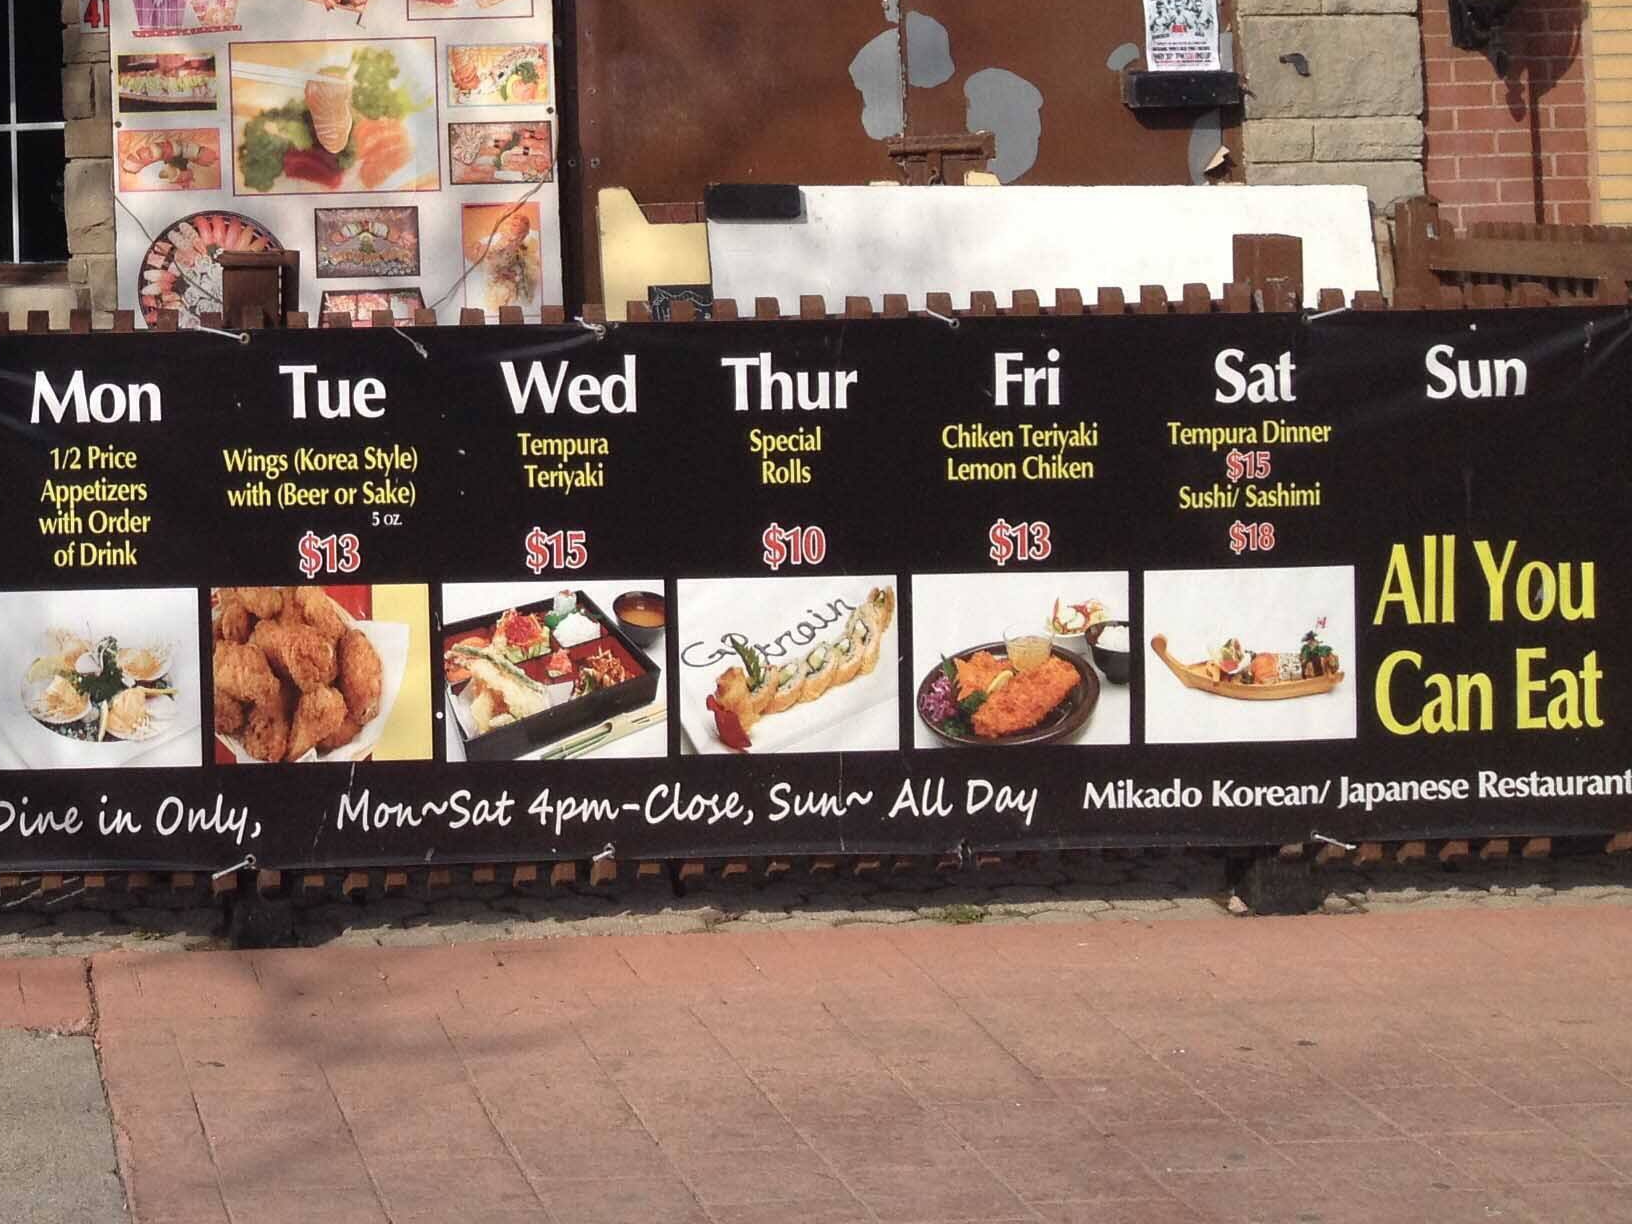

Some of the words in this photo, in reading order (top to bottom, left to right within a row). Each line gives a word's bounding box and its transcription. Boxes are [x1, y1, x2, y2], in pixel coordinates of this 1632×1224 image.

[499, 354, 637, 415] Wed
[720, 351, 858, 411] Thur
[994, 348, 1060, 406] Fri
[1214, 348, 1297, 404] Sat
[1425, 344, 1528, 400] Sun
[30, 369, 162, 424] Mon
[278, 364, 387, 419] Tue
[517, 432, 609, 463] Tempura
[749, 425, 822, 460] Special
[942, 422, 1014, 449] Chiken
[1018, 421, 1098, 454] Teriyaki
[1167, 421, 1258, 451] Tempura
[1262, 418, 1332, 444] Dinner
[49, 446, 82, 470] 1/2
[87, 444, 137, 470] Price
[222, 447, 289, 479] Wings
[294, 447, 359, 474] (Korea
[364, 444, 418, 475] Style)
[762, 458, 812, 484] Rolls
[947, 457, 1017, 481] Lemon
[1022, 451, 1094, 480] Chiken
[1225, 447, 1272, 484] $15
[40, 477, 148, 509] Appetizers
[227, 481, 271, 507] with
[277, 482, 330, 510] (Beer
[334, 487, 358, 505] or
[362, 478, 416, 507] Sake)
[523, 462, 604, 495] Teriyaki
[1179, 483, 1240, 509] Sushi/
[1245, 481, 1321, 508] Sashimi
[38, 505, 83, 535] with
[89, 507, 151, 534] Order
[372, 511, 380, 526] 5
[383, 513, 403, 526] oz.
[1228, 519, 1276, 555] $18
[54, 541, 76, 567] of
[80, 539, 137, 566] Drink
[298, 530, 361, 579] $13
[524, 526, 588, 575] $15
[762, 522, 827, 571] $10
[988, 518, 1052, 567] $13
[1372, 534, 1456, 625] All
[1472, 540, 1596, 622] You
[1375, 649, 1493, 736] Can
[1515, 647, 1605, 730] Eat
[888, 777, 954, 818] All
[966, 779, 1038, 826] Day
[1083, 778, 1203, 809] Mikado
[1212, 779, 1332, 807] Korean/
[1337, 776, 1470, 812] Japanese
[1478, 769, 1632, 798] Restaurant
[98, 794, 142, 836] in
[155, 793, 262, 843] Only,
